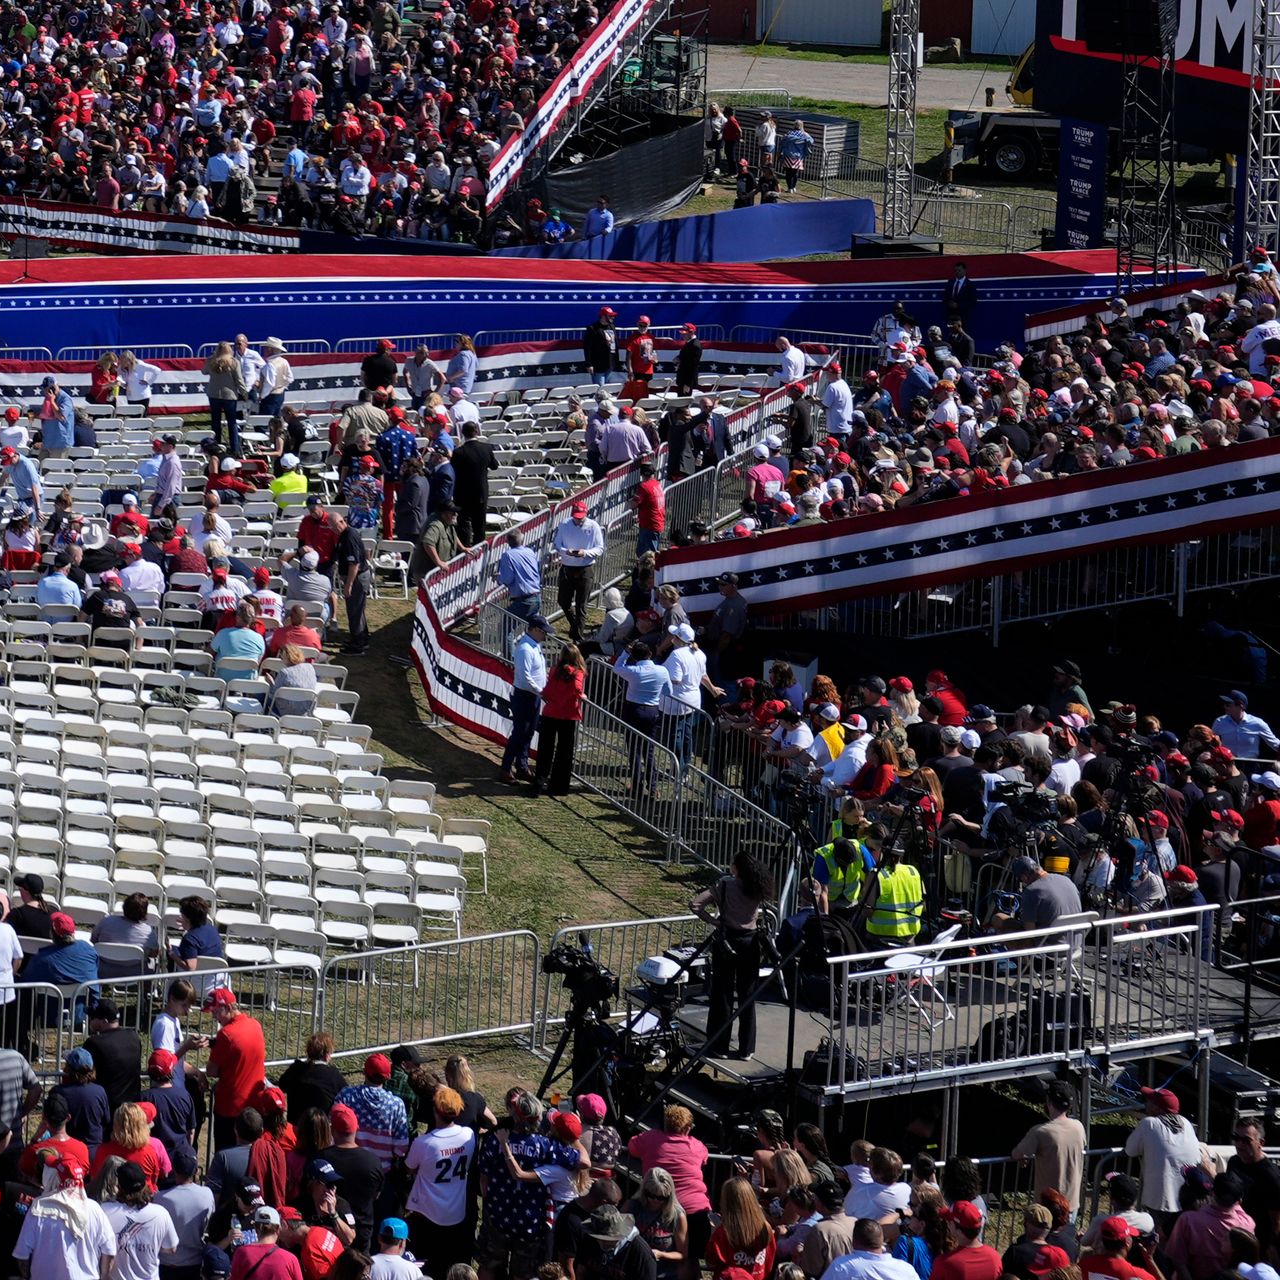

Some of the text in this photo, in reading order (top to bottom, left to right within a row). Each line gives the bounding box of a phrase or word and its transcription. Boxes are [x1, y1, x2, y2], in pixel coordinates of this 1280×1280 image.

[1072, 127, 1095, 138] TRUMP
[1074, 135, 1092, 144] VANCE
[1070, 178, 1092, 189] TRUMP
[1072, 186, 1089, 195] VANCE
[1067, 230, 1090, 242] TRUMP
[1069, 238, 1087, 247] VANCE
[439, 1146, 466, 1158] TRUMP
[434, 1155, 468, 1184] 24
